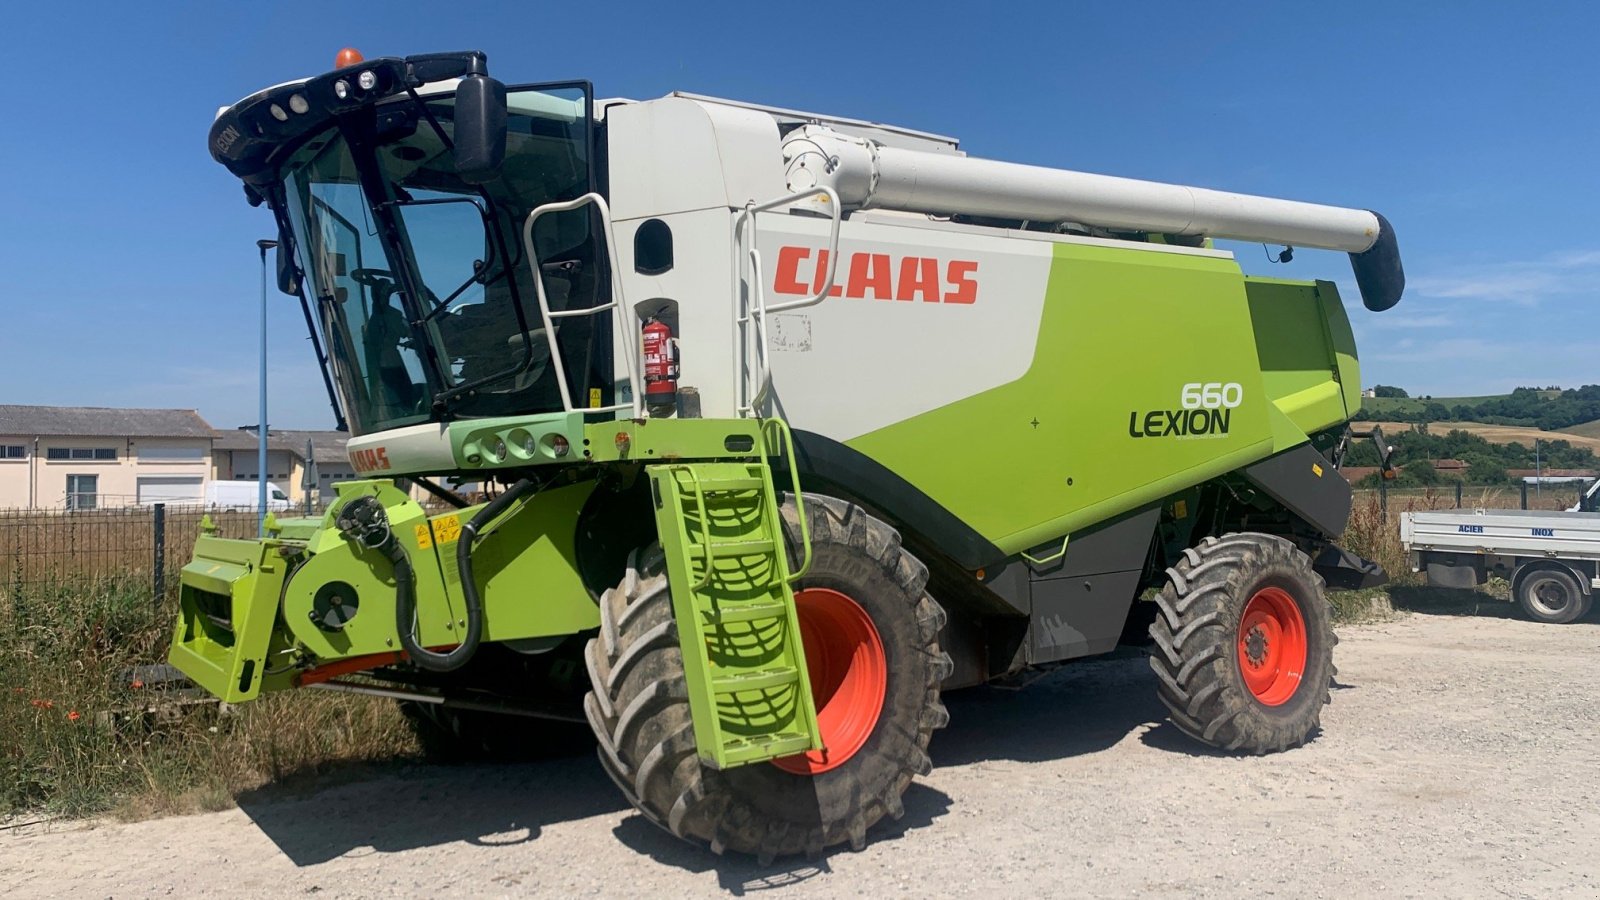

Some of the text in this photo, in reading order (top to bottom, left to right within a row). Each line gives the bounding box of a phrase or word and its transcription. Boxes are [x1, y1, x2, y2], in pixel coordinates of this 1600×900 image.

[774, 246, 978, 304] CLAAS
[1181, 382, 1242, 409] 660
[1129, 408, 1230, 438] LEXION
[1458, 525, 1554, 537] ACIER INOX
